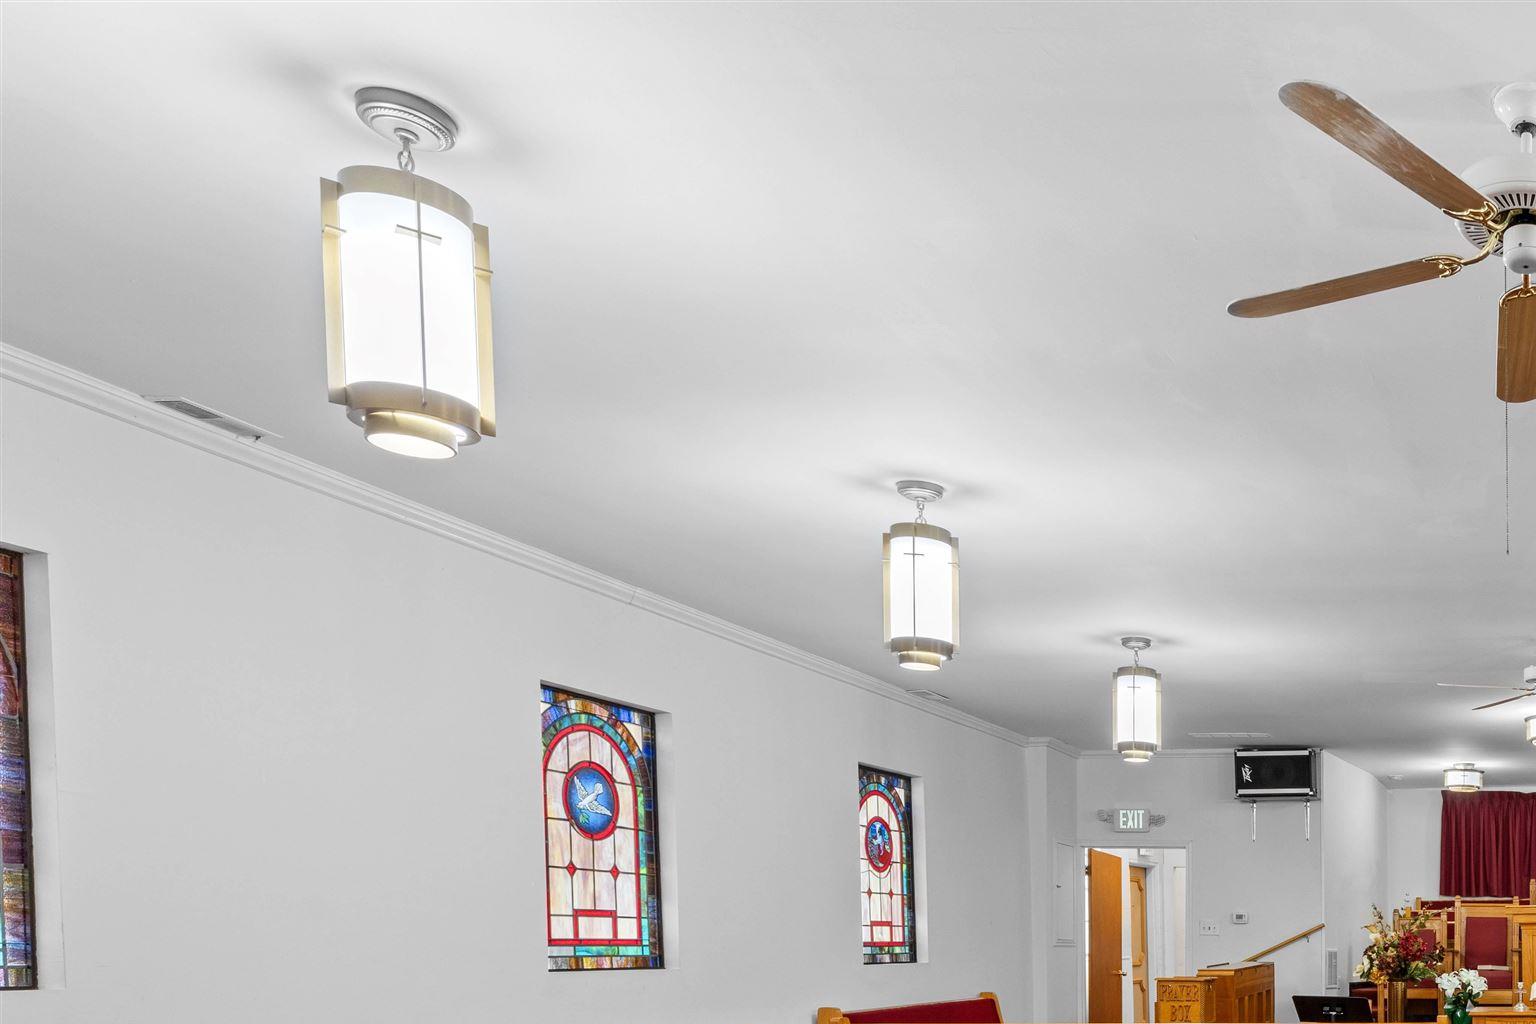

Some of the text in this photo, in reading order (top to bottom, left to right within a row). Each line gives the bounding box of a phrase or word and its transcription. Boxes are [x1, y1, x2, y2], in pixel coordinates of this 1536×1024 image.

[1119, 809, 1145, 829] EXIT
[1159, 984, 1200, 1002] PRAYER
[1169, 1005, 1192, 1023] BOX
